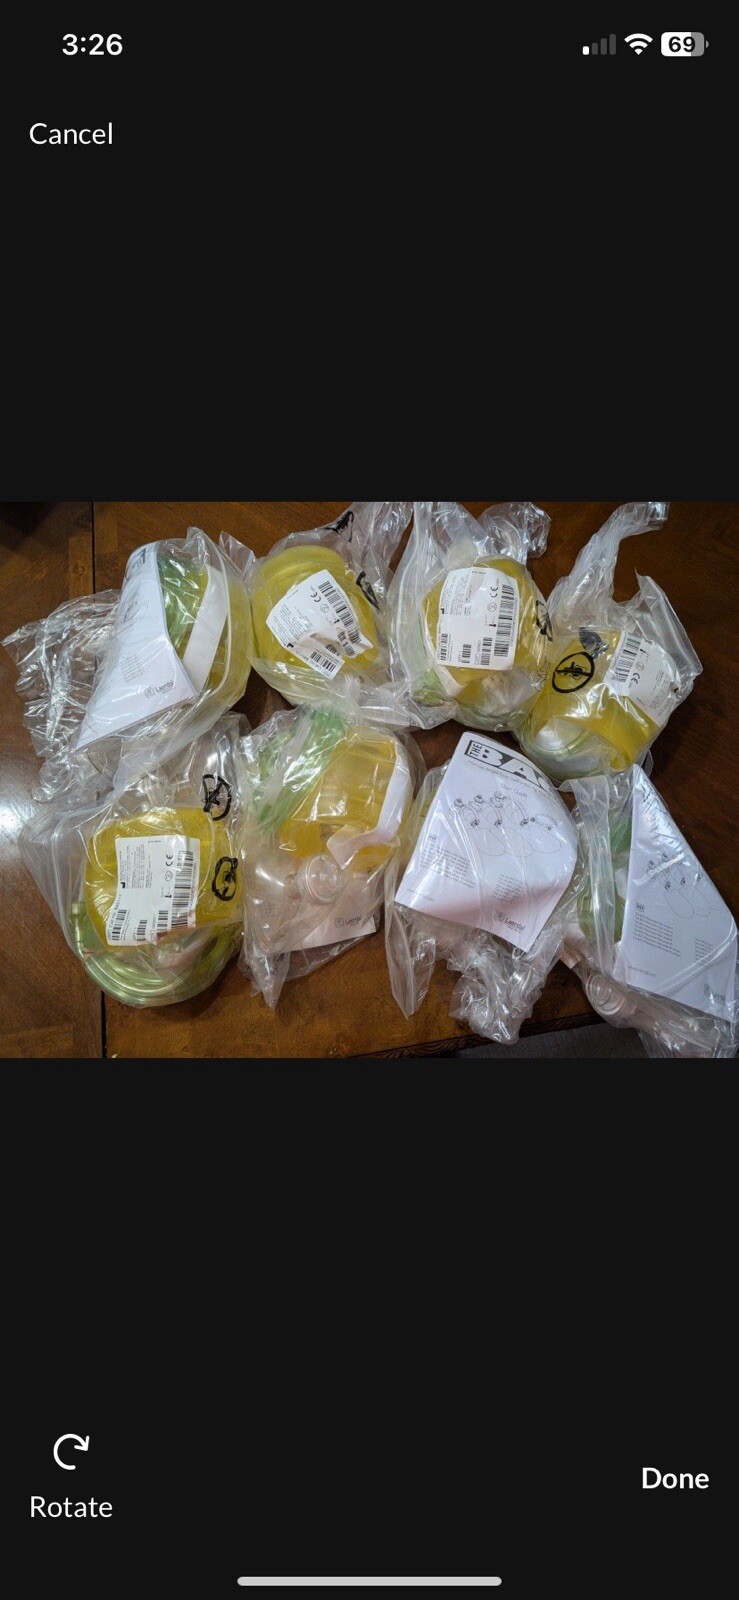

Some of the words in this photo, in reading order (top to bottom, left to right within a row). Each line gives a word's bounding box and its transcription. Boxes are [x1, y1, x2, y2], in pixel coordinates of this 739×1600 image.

[62, 34, 122, 55] 3:26
[668, 36, 696, 52] 69
[29, 122, 112, 144] Cancel
[469, 743, 483, 758] THE
[642, 1467, 709, 1490] Done
[30, 1496, 112, 1518] Rotate
